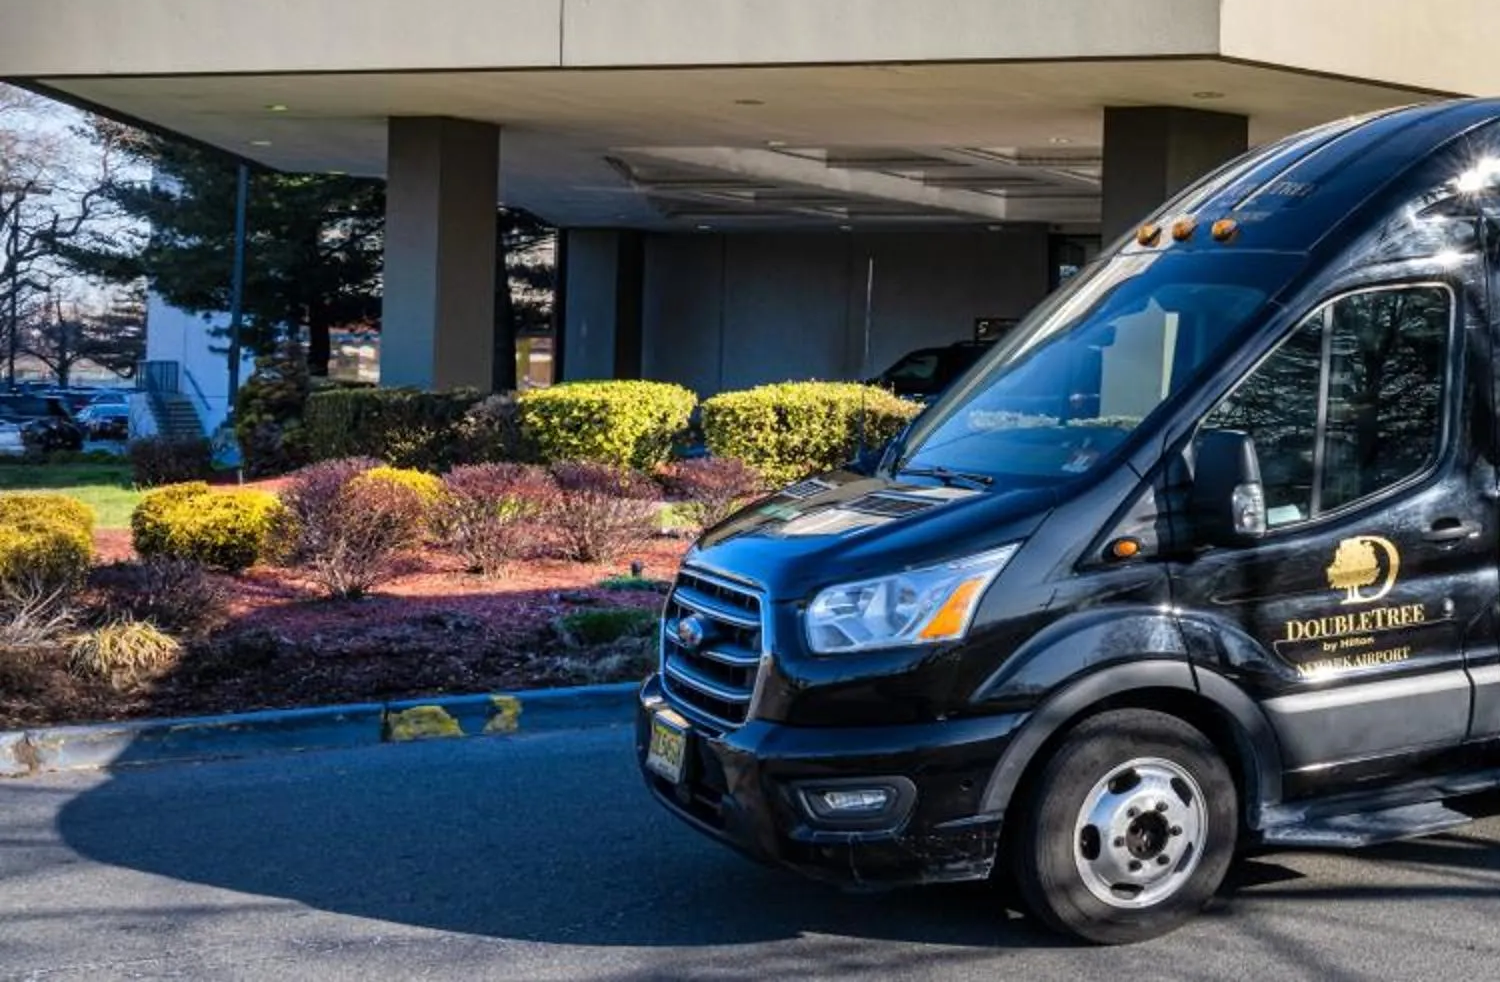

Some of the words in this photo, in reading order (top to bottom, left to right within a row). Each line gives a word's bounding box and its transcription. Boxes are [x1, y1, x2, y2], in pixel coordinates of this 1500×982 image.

[1285, 603, 1426, 641] DOUBLETREE
[1323, 641, 1338, 652] by
[1353, 646, 1411, 667] AIRPORT
